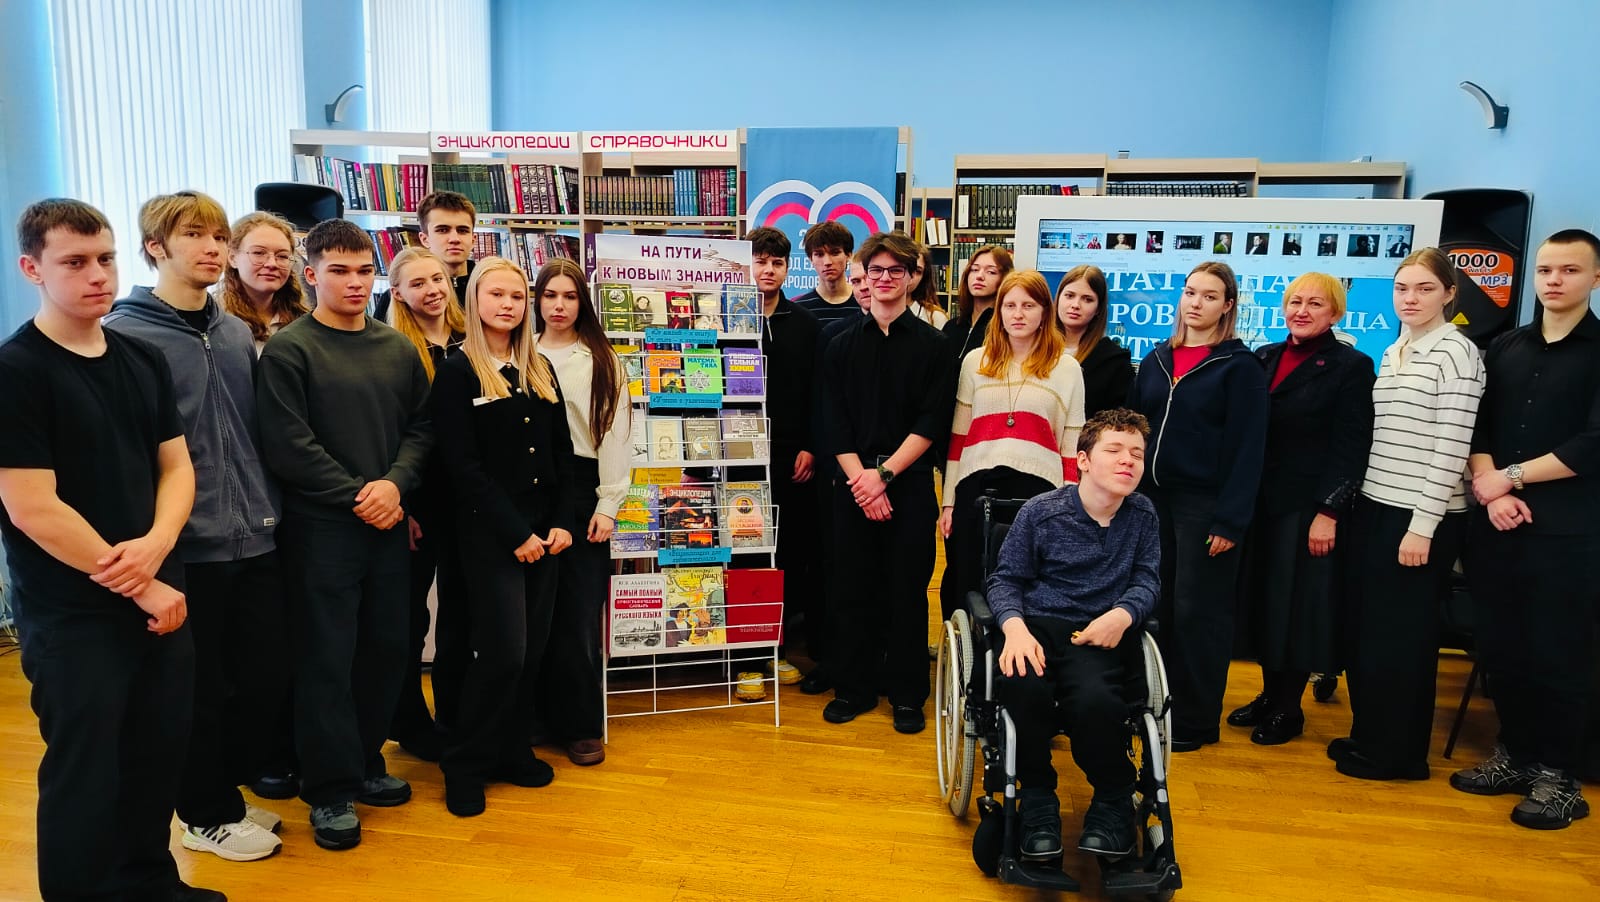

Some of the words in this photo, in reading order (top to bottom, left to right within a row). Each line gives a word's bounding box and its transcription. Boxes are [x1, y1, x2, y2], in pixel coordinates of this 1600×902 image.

[437, 135, 570, 149] ЭНЦИКЛОПЕДИИ
[590, 135, 727, 148] СПРАВОЧНИКИ
[641, 245, 660, 258] НА
[666, 246, 702, 259] ПУТИ
[1447, 253, 1499, 269] 1000
[603, 266, 611, 279] К
[617, 267, 671, 281] НОВЫМ
[676, 269, 744, 283] ЗНАНИЯМ
[1480, 275, 1509, 286] MP3
[669, 489, 712, 498] ЭНЦИКЛОПЕДИЯ
[639, 588, 662, 596] ПОЛНЫЙ
